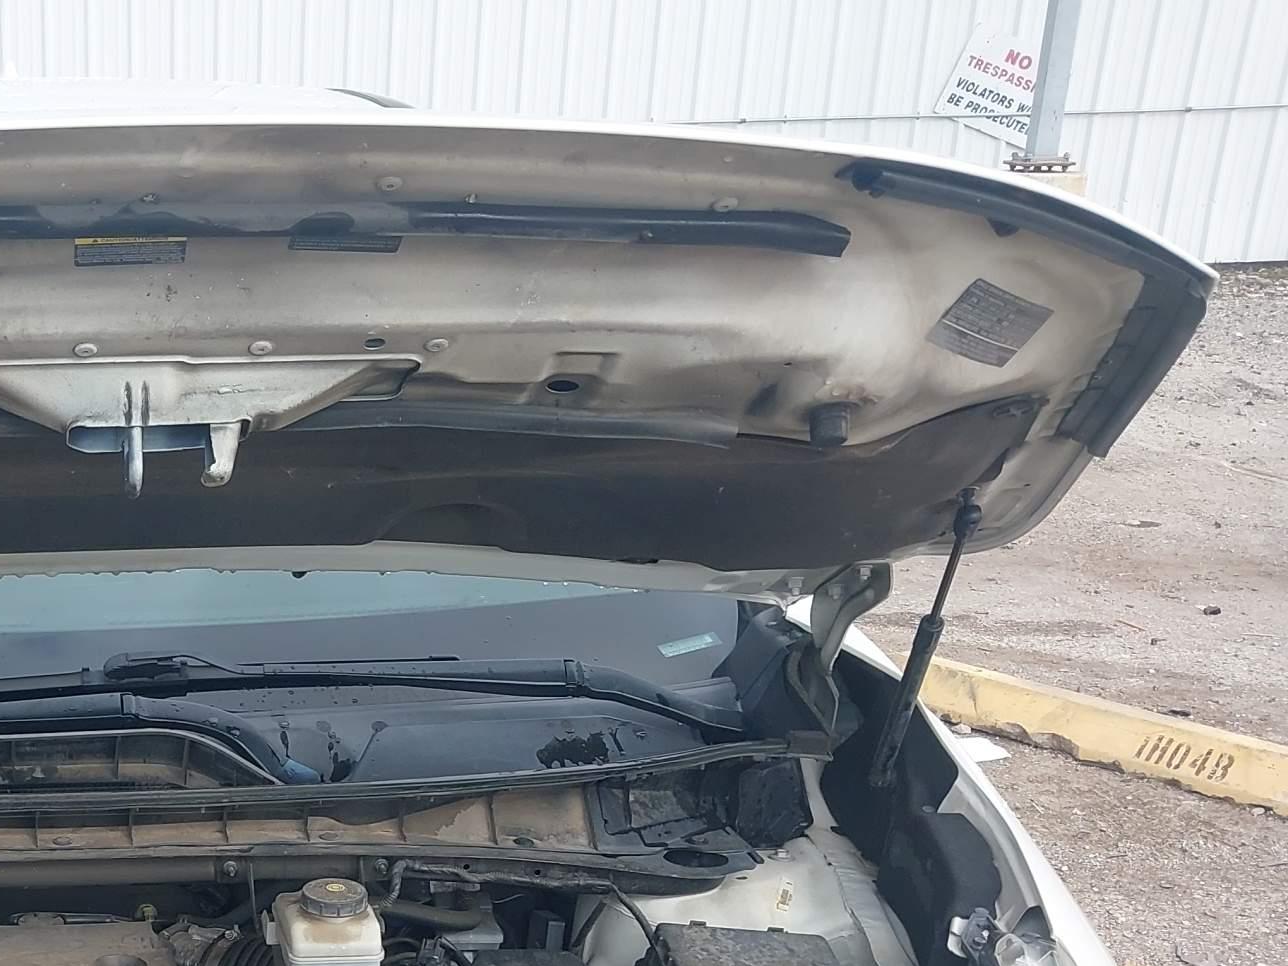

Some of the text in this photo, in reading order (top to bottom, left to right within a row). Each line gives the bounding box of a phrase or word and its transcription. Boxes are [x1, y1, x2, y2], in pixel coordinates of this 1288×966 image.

[1004, 49, 1032, 70] NO
[947, 92, 964, 107] BE
[956, 77, 1014, 109] VIOLATORS
